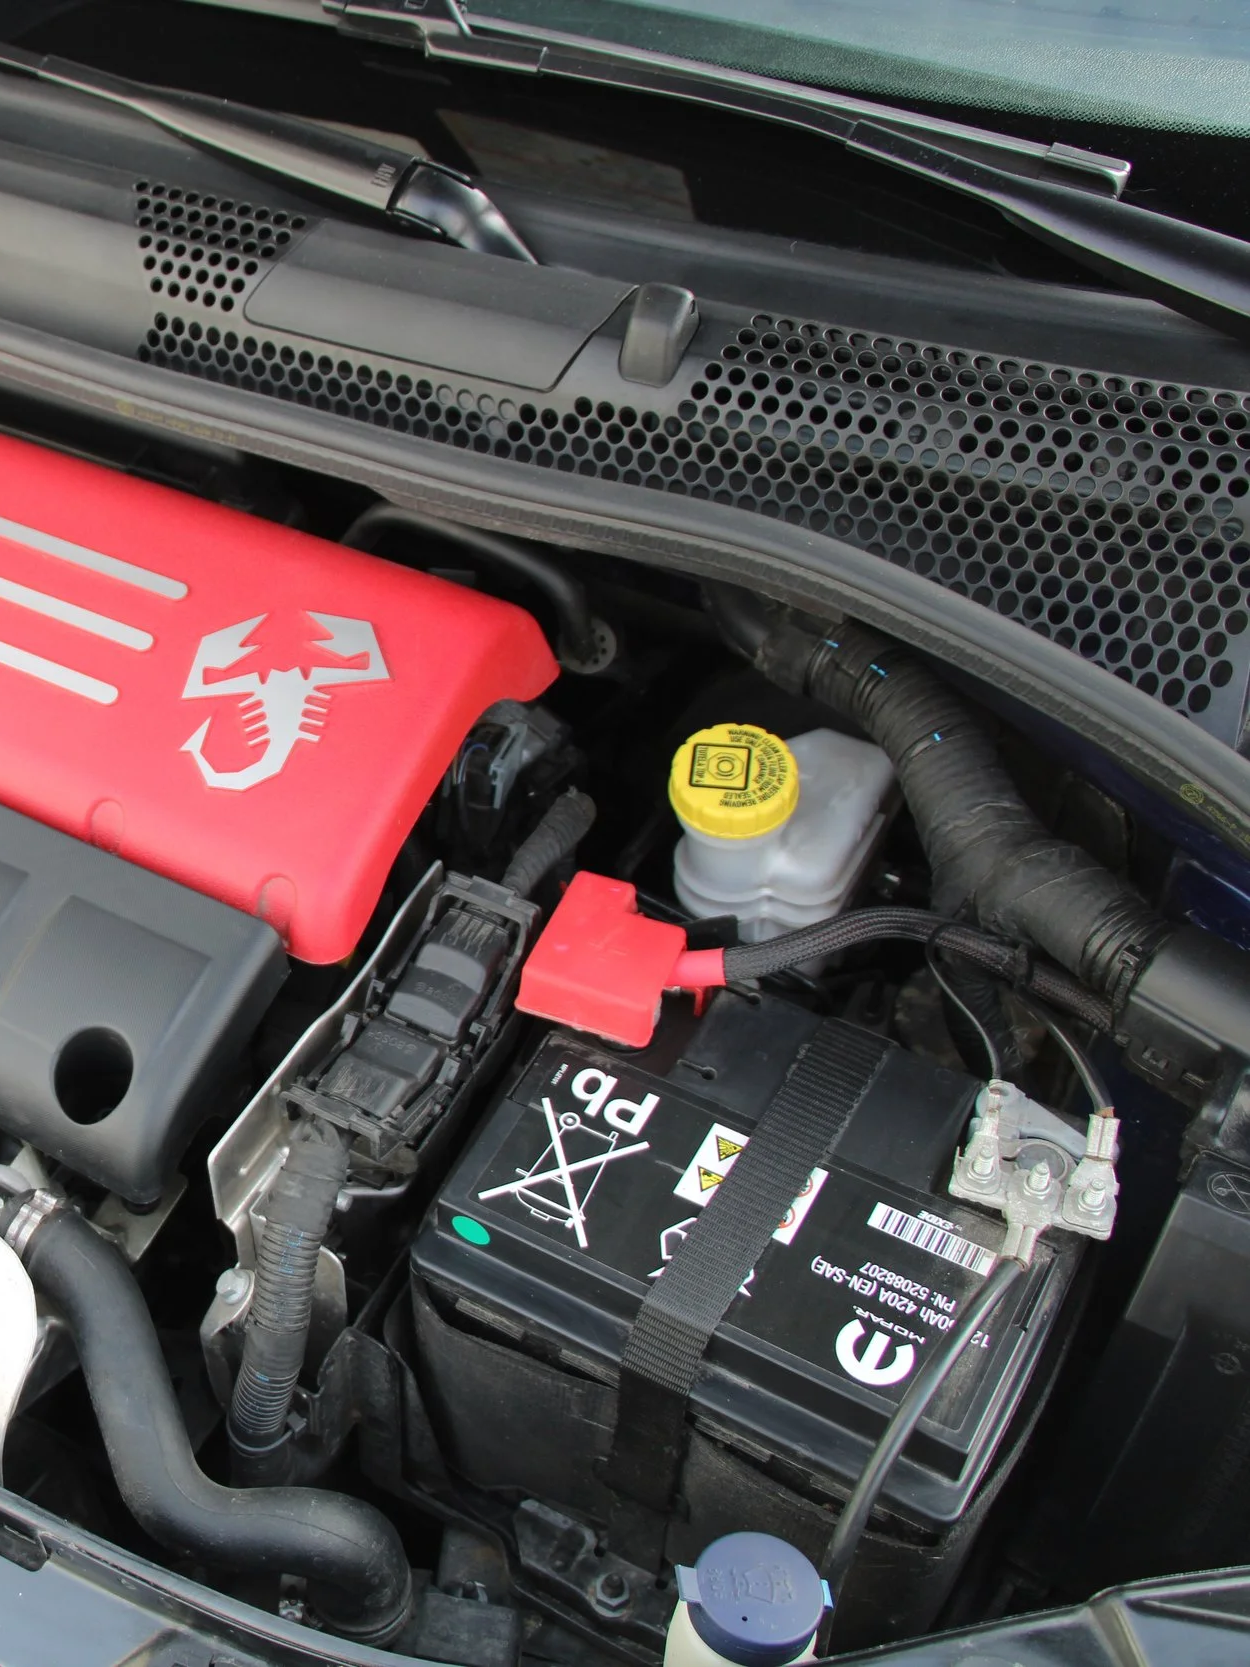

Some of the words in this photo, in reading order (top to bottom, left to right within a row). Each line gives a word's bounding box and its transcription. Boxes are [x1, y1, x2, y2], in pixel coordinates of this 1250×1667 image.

[719, 799, 757, 808] REMOVING
[723, 791, 751, 800] SEALED
[757, 785, 781, 803] BEFORE
[571, 1068, 661, 1137] Pb
[917, 1209, 955, 1231] EXIDE
[810, 1255, 878, 1297] (EN-SAE)
[858, 1261, 931, 1301] 52088207
[878, 1287, 919, 1316] 420A
[931, 1291, 958, 1314] PN:
